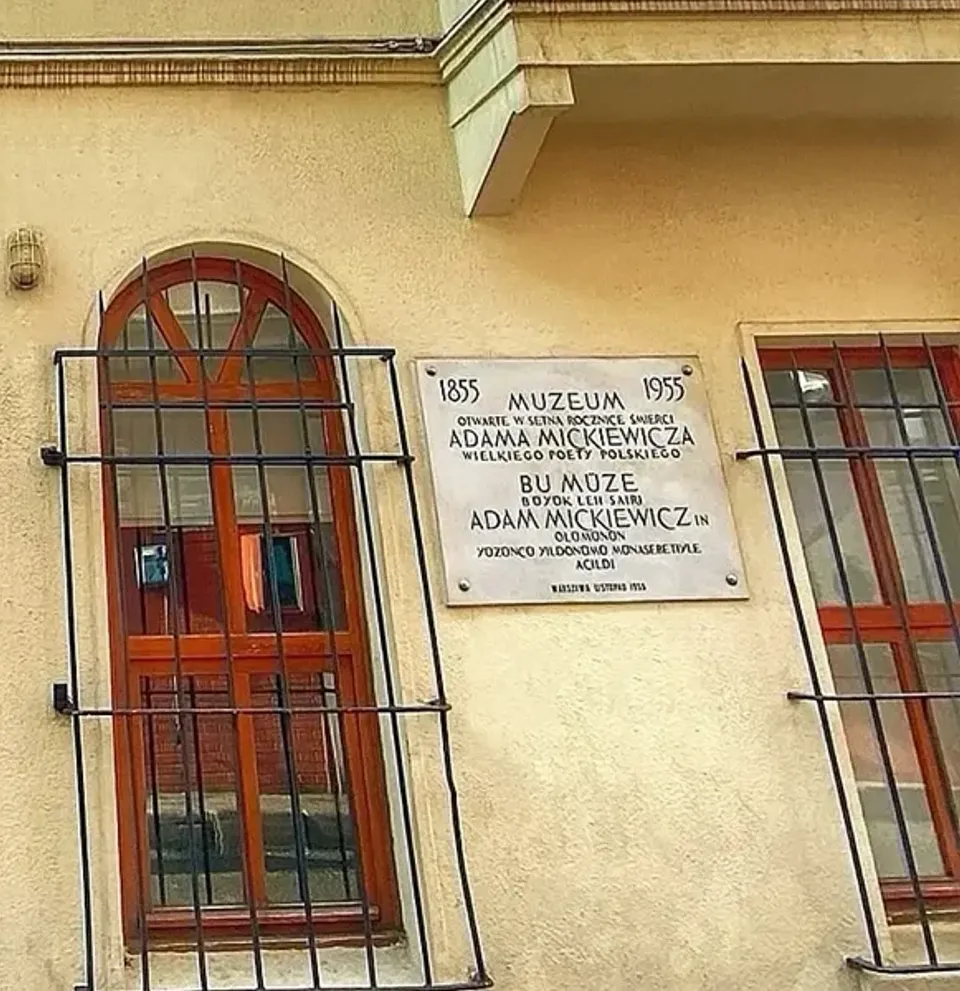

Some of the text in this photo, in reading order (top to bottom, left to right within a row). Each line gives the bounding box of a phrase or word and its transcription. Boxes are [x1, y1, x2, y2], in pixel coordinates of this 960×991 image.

[439, 378, 480, 404] 1855
[643, 376, 685, 402] 1955
[508, 392, 625, 411] MUZEUM
[457, 415, 510, 427] OTWARTE
[513, 415, 524, 426] W
[449, 426, 695, 449] ADAMA MICKIEWICZA
[462, 448, 681, 462] WIELKIEGO POETY POLSKIEGO
[520, 474, 552, 493] BU
[470, 509, 540, 530] ADAM
[545, 507, 692, 531] MICKIEWICZ
